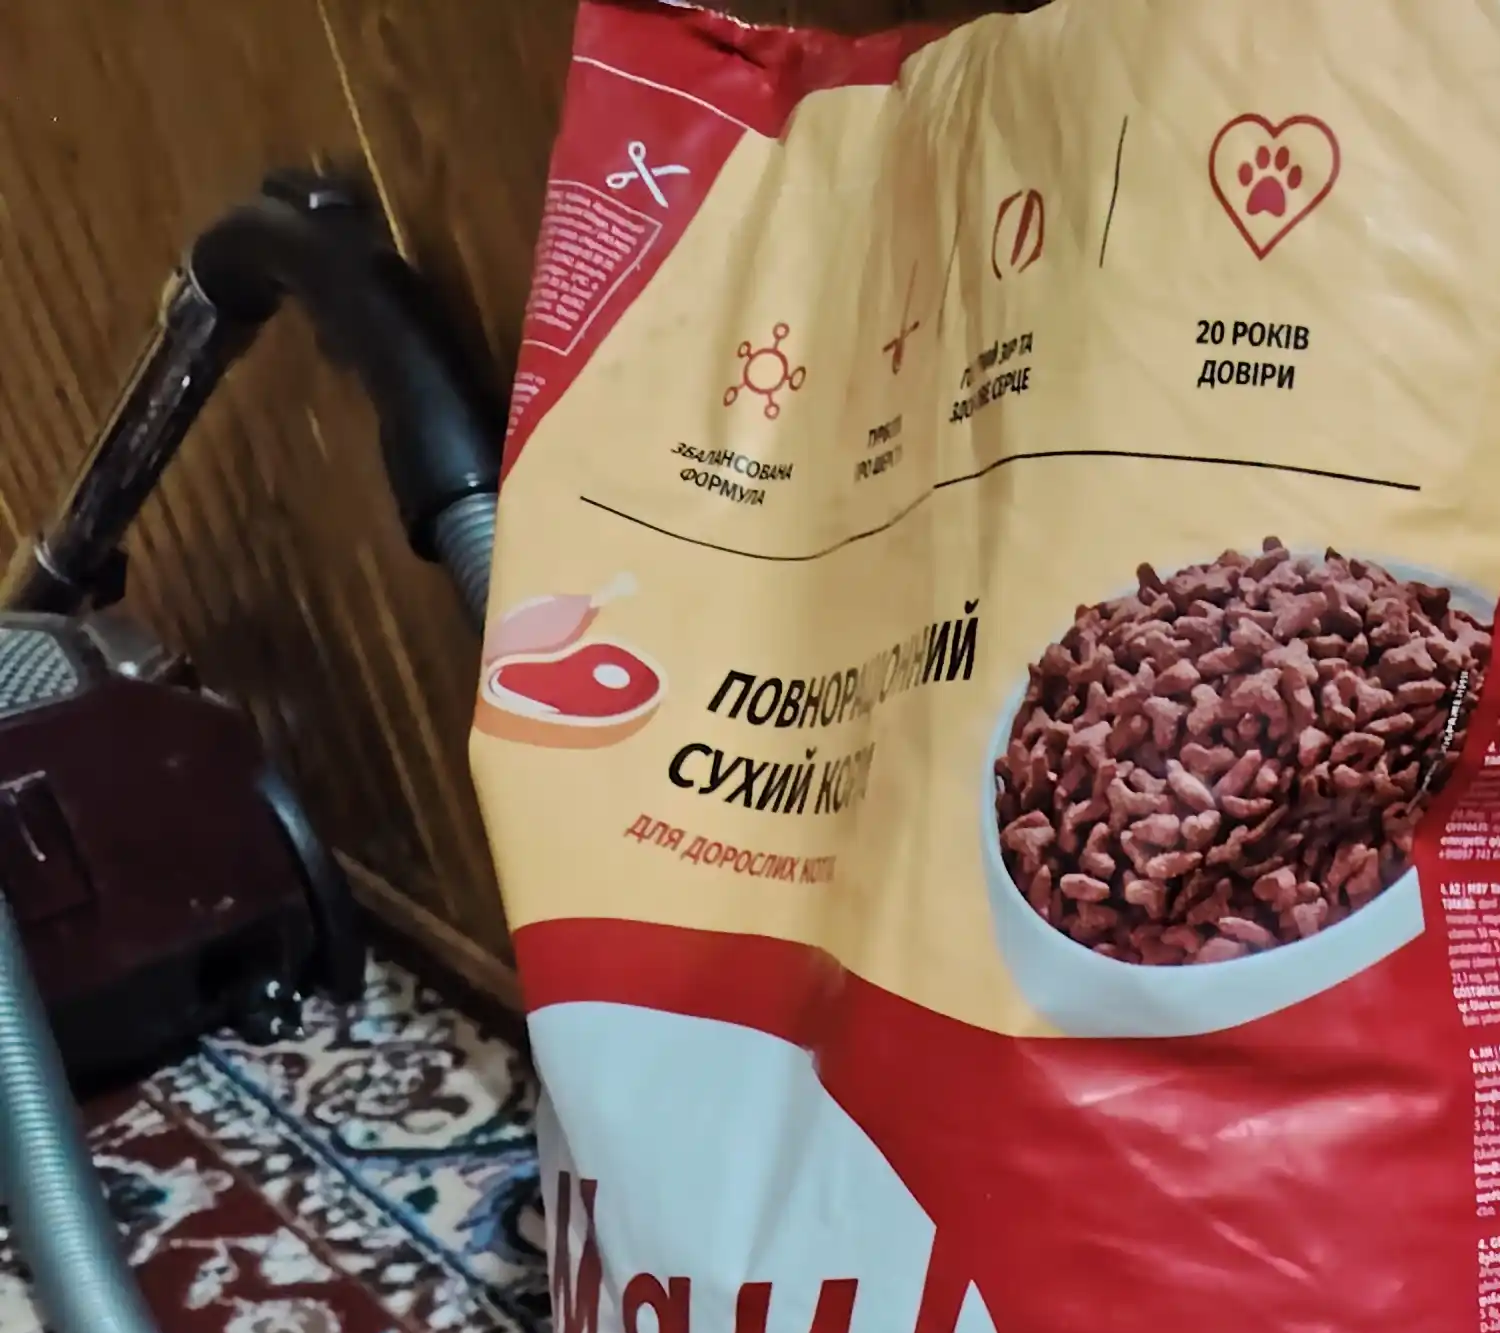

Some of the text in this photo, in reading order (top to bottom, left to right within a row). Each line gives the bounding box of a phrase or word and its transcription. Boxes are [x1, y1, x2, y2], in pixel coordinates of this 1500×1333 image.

[1195, 319, 1310, 350] 20 РОКІВ
[1196, 359, 1295, 390] ДОВІРИ
[670, 442, 794, 481] ЗБАЛАНСОВАНА
[680, 467, 766, 505] ФОРМУЛА
[668, 742, 817, 815] СУХИЙ
[623, 812, 686, 851] ДЛЯ
[684, 835, 799, 883] ДОРОСЛИХ
